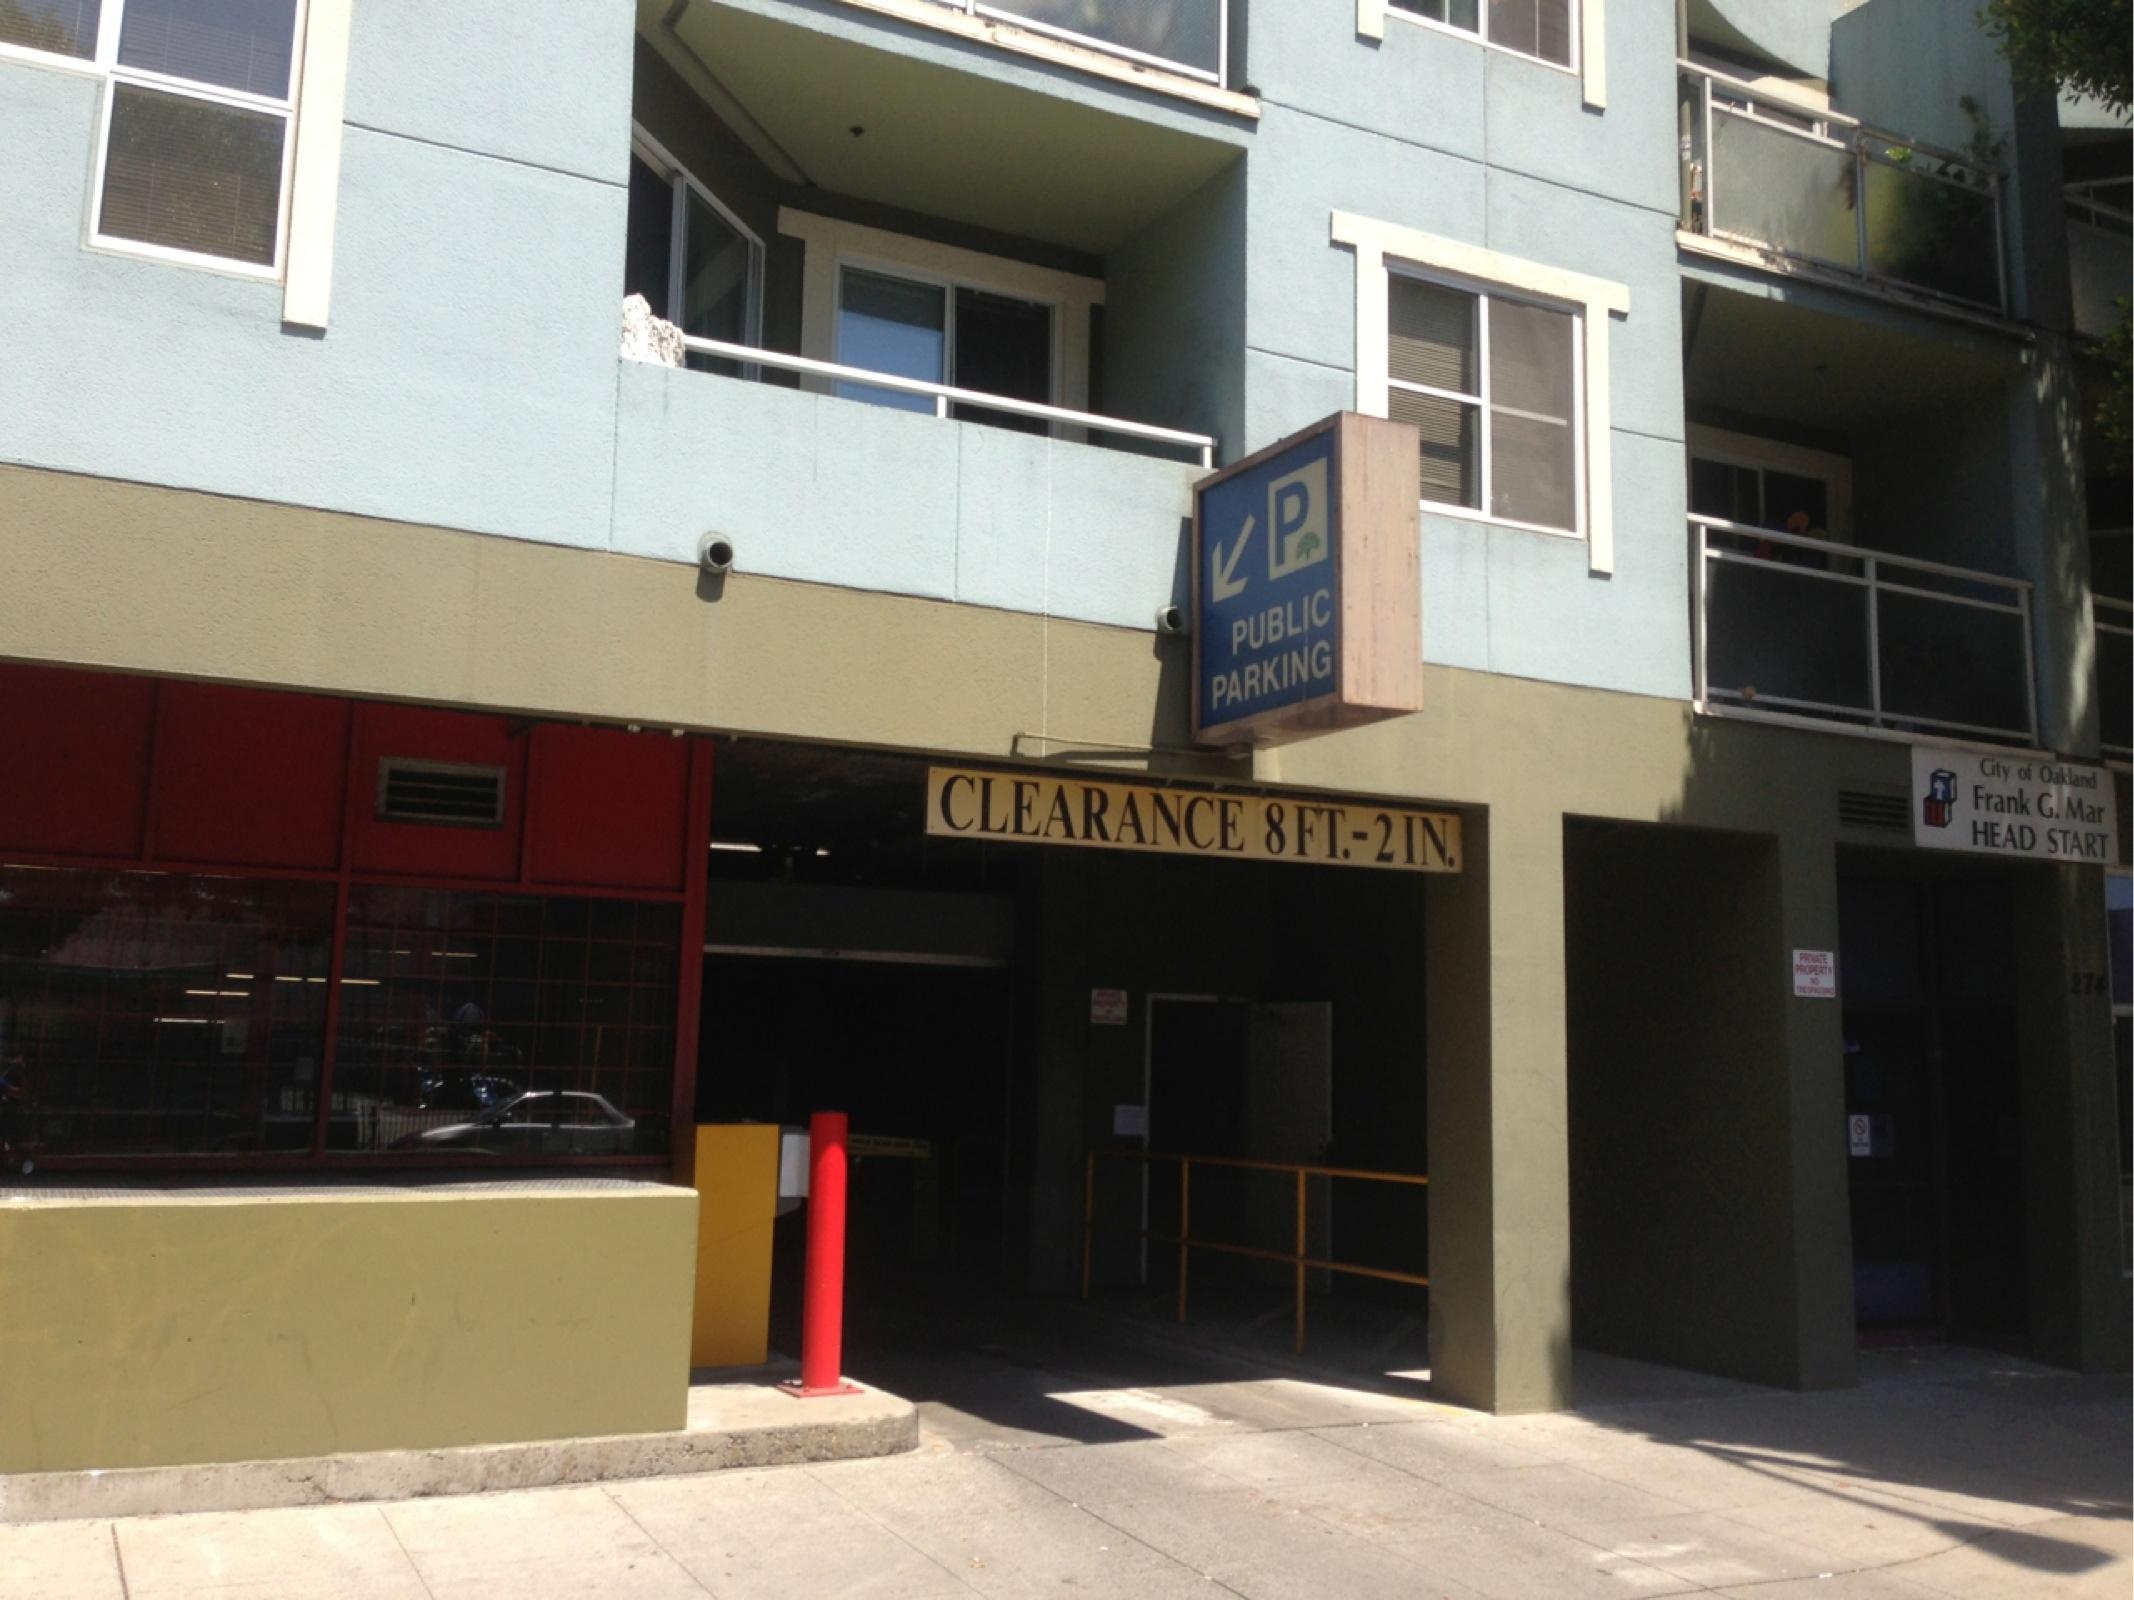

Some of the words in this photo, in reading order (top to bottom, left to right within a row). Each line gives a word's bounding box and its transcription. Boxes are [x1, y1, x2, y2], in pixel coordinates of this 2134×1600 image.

[1275, 481, 1309, 569] P
[1232, 588, 1331, 656] PUBLIC
[1211, 640, 1332, 711] PARKING
[1980, 757, 2011, 783] City
[2018, 762, 2033, 779] of
[2040, 765, 2097, 790] Oakland
[940, 773, 1246, 852] CLEARANCE
[1973, 784, 2031, 816] Frank
[2037, 792, 2059, 820] G.
[2065, 796, 2106, 824] Mar
[1971, 819, 2037, 851] HEAD
[2047, 827, 2109, 859] START
[1795, 964, 1833, 976] PROPERTY
[1799, 952, 1828, 964] PRIVATE
